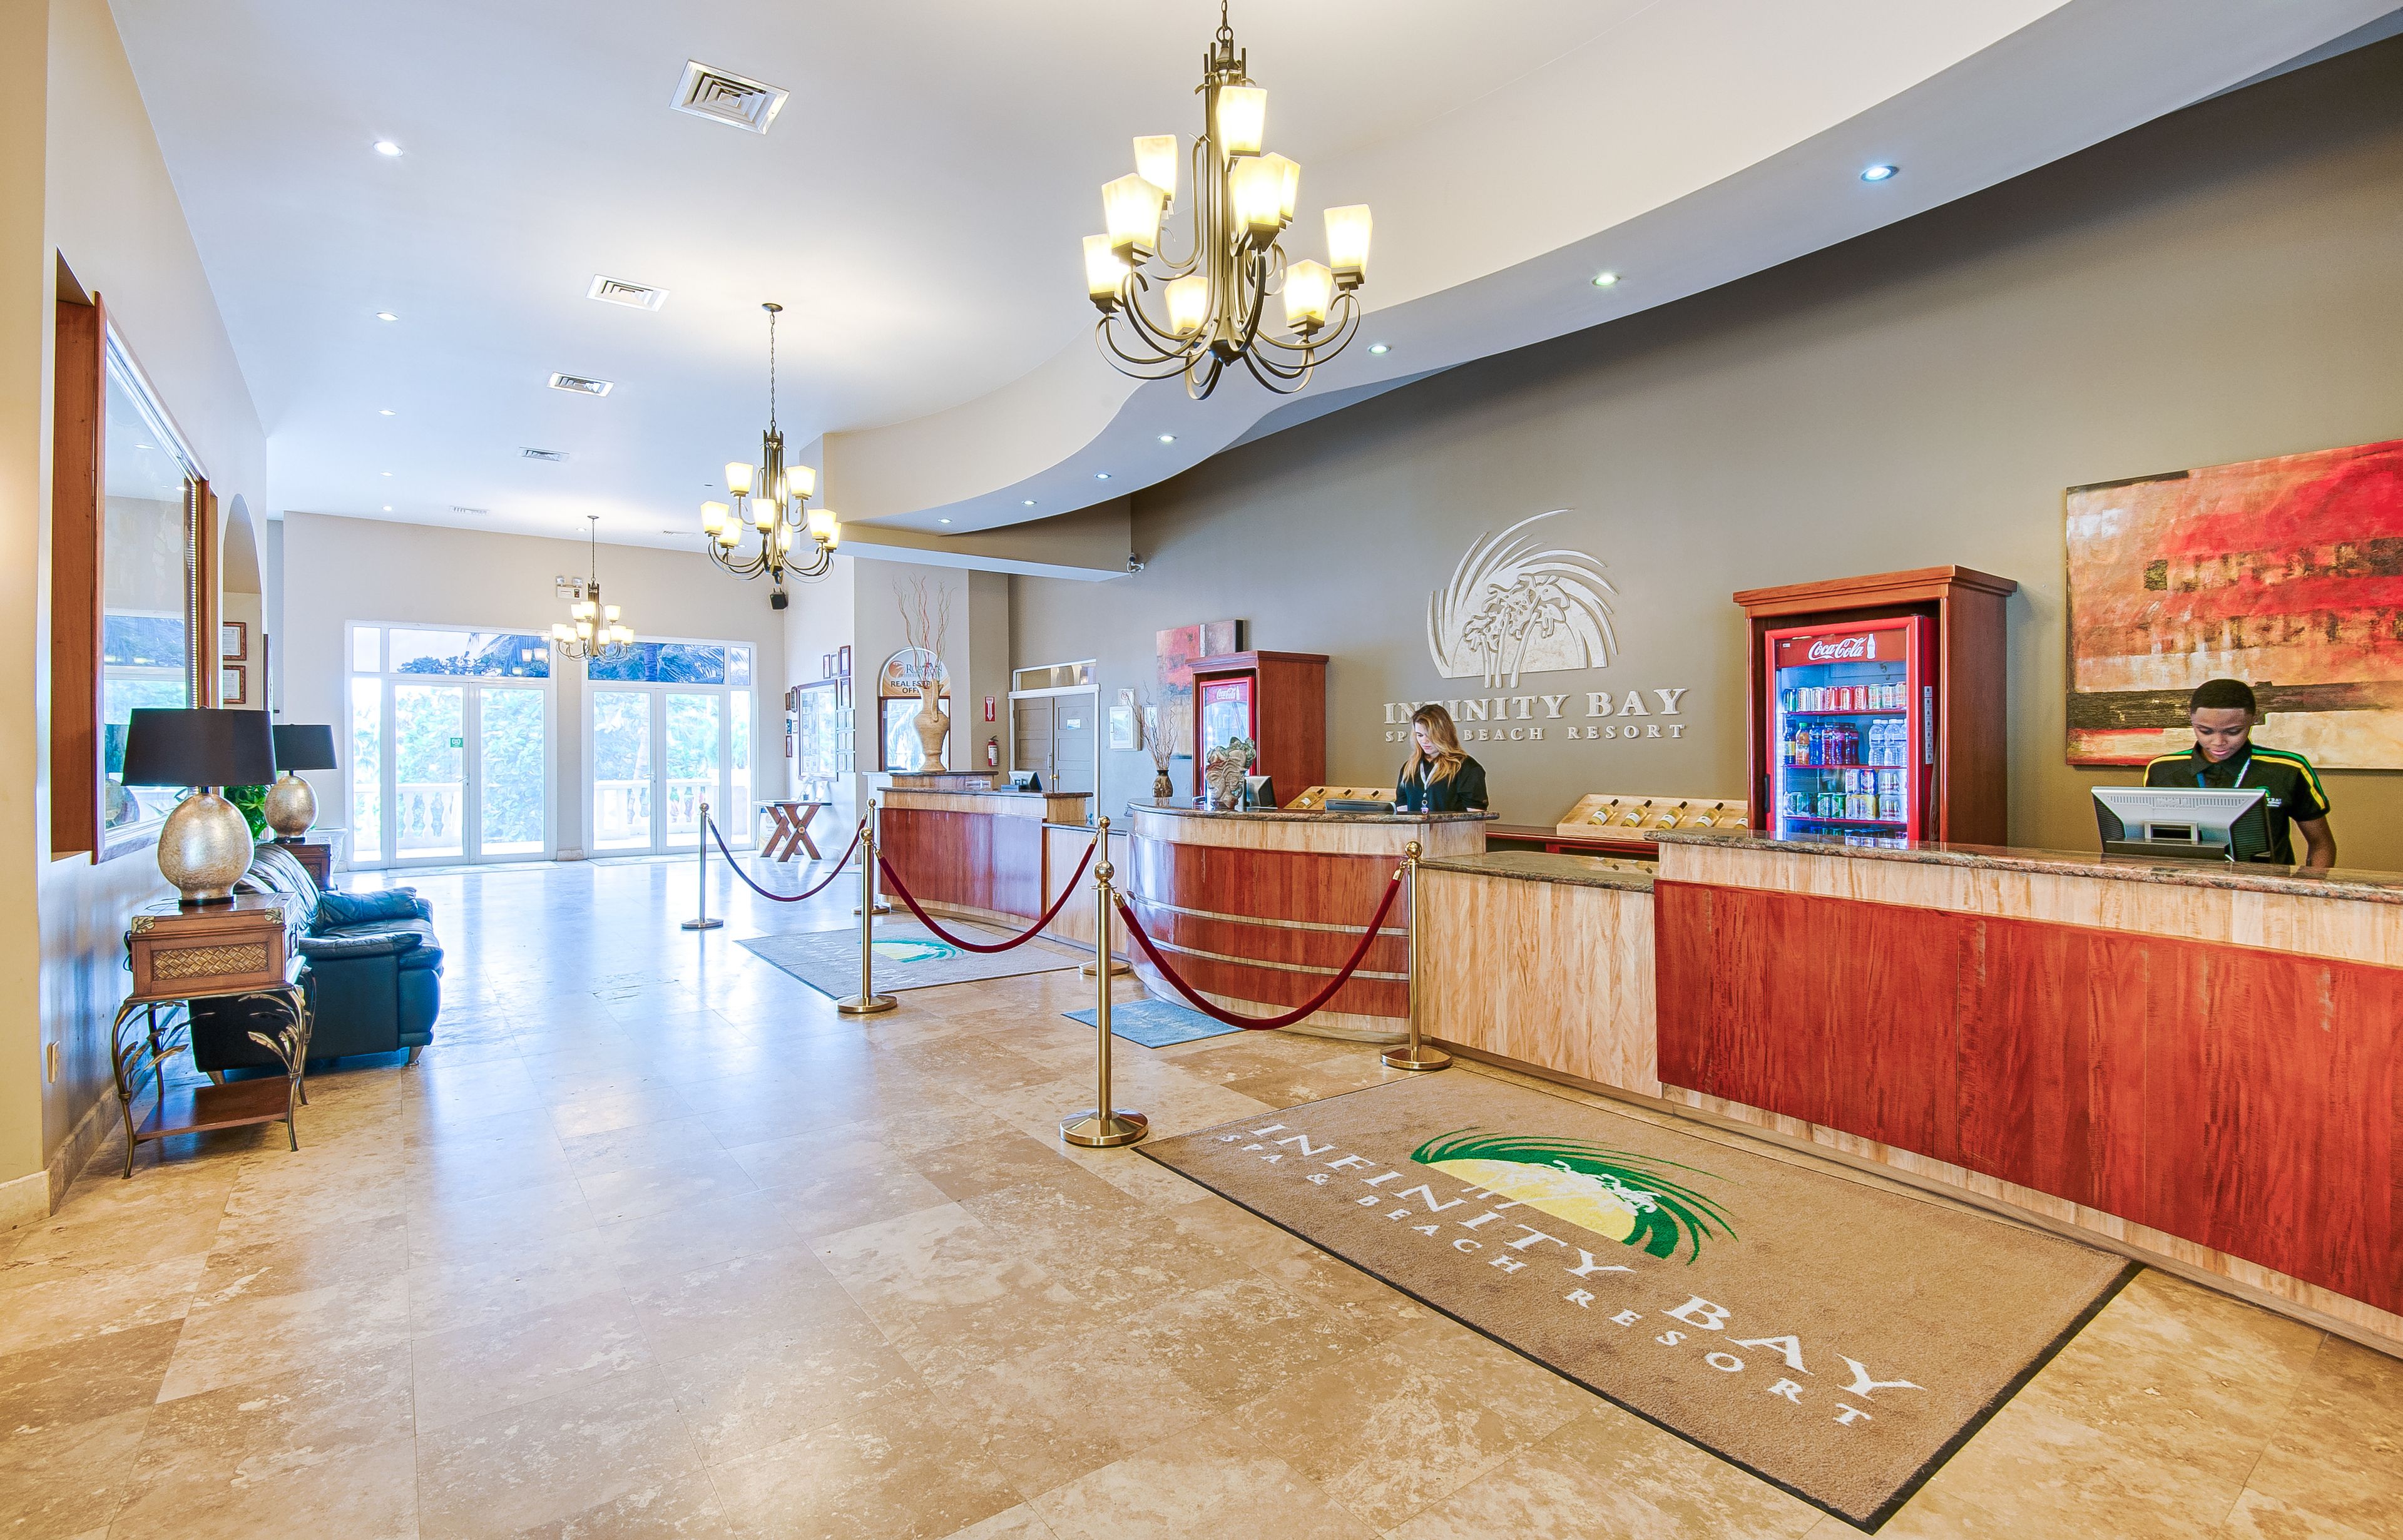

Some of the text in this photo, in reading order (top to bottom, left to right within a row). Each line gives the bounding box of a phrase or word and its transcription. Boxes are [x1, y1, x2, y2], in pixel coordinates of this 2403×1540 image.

[1808, 637, 1867, 661] Coca-Cola
[1384, 688, 1688, 725] ININITY BAY
[1385, 723, 1685, 742] SP BEACH RESORT
[1218, 1134, 1872, 1426] SPA & BEACH RESORT
[1251, 1123, 1927, 1402] INFINITY BAY
